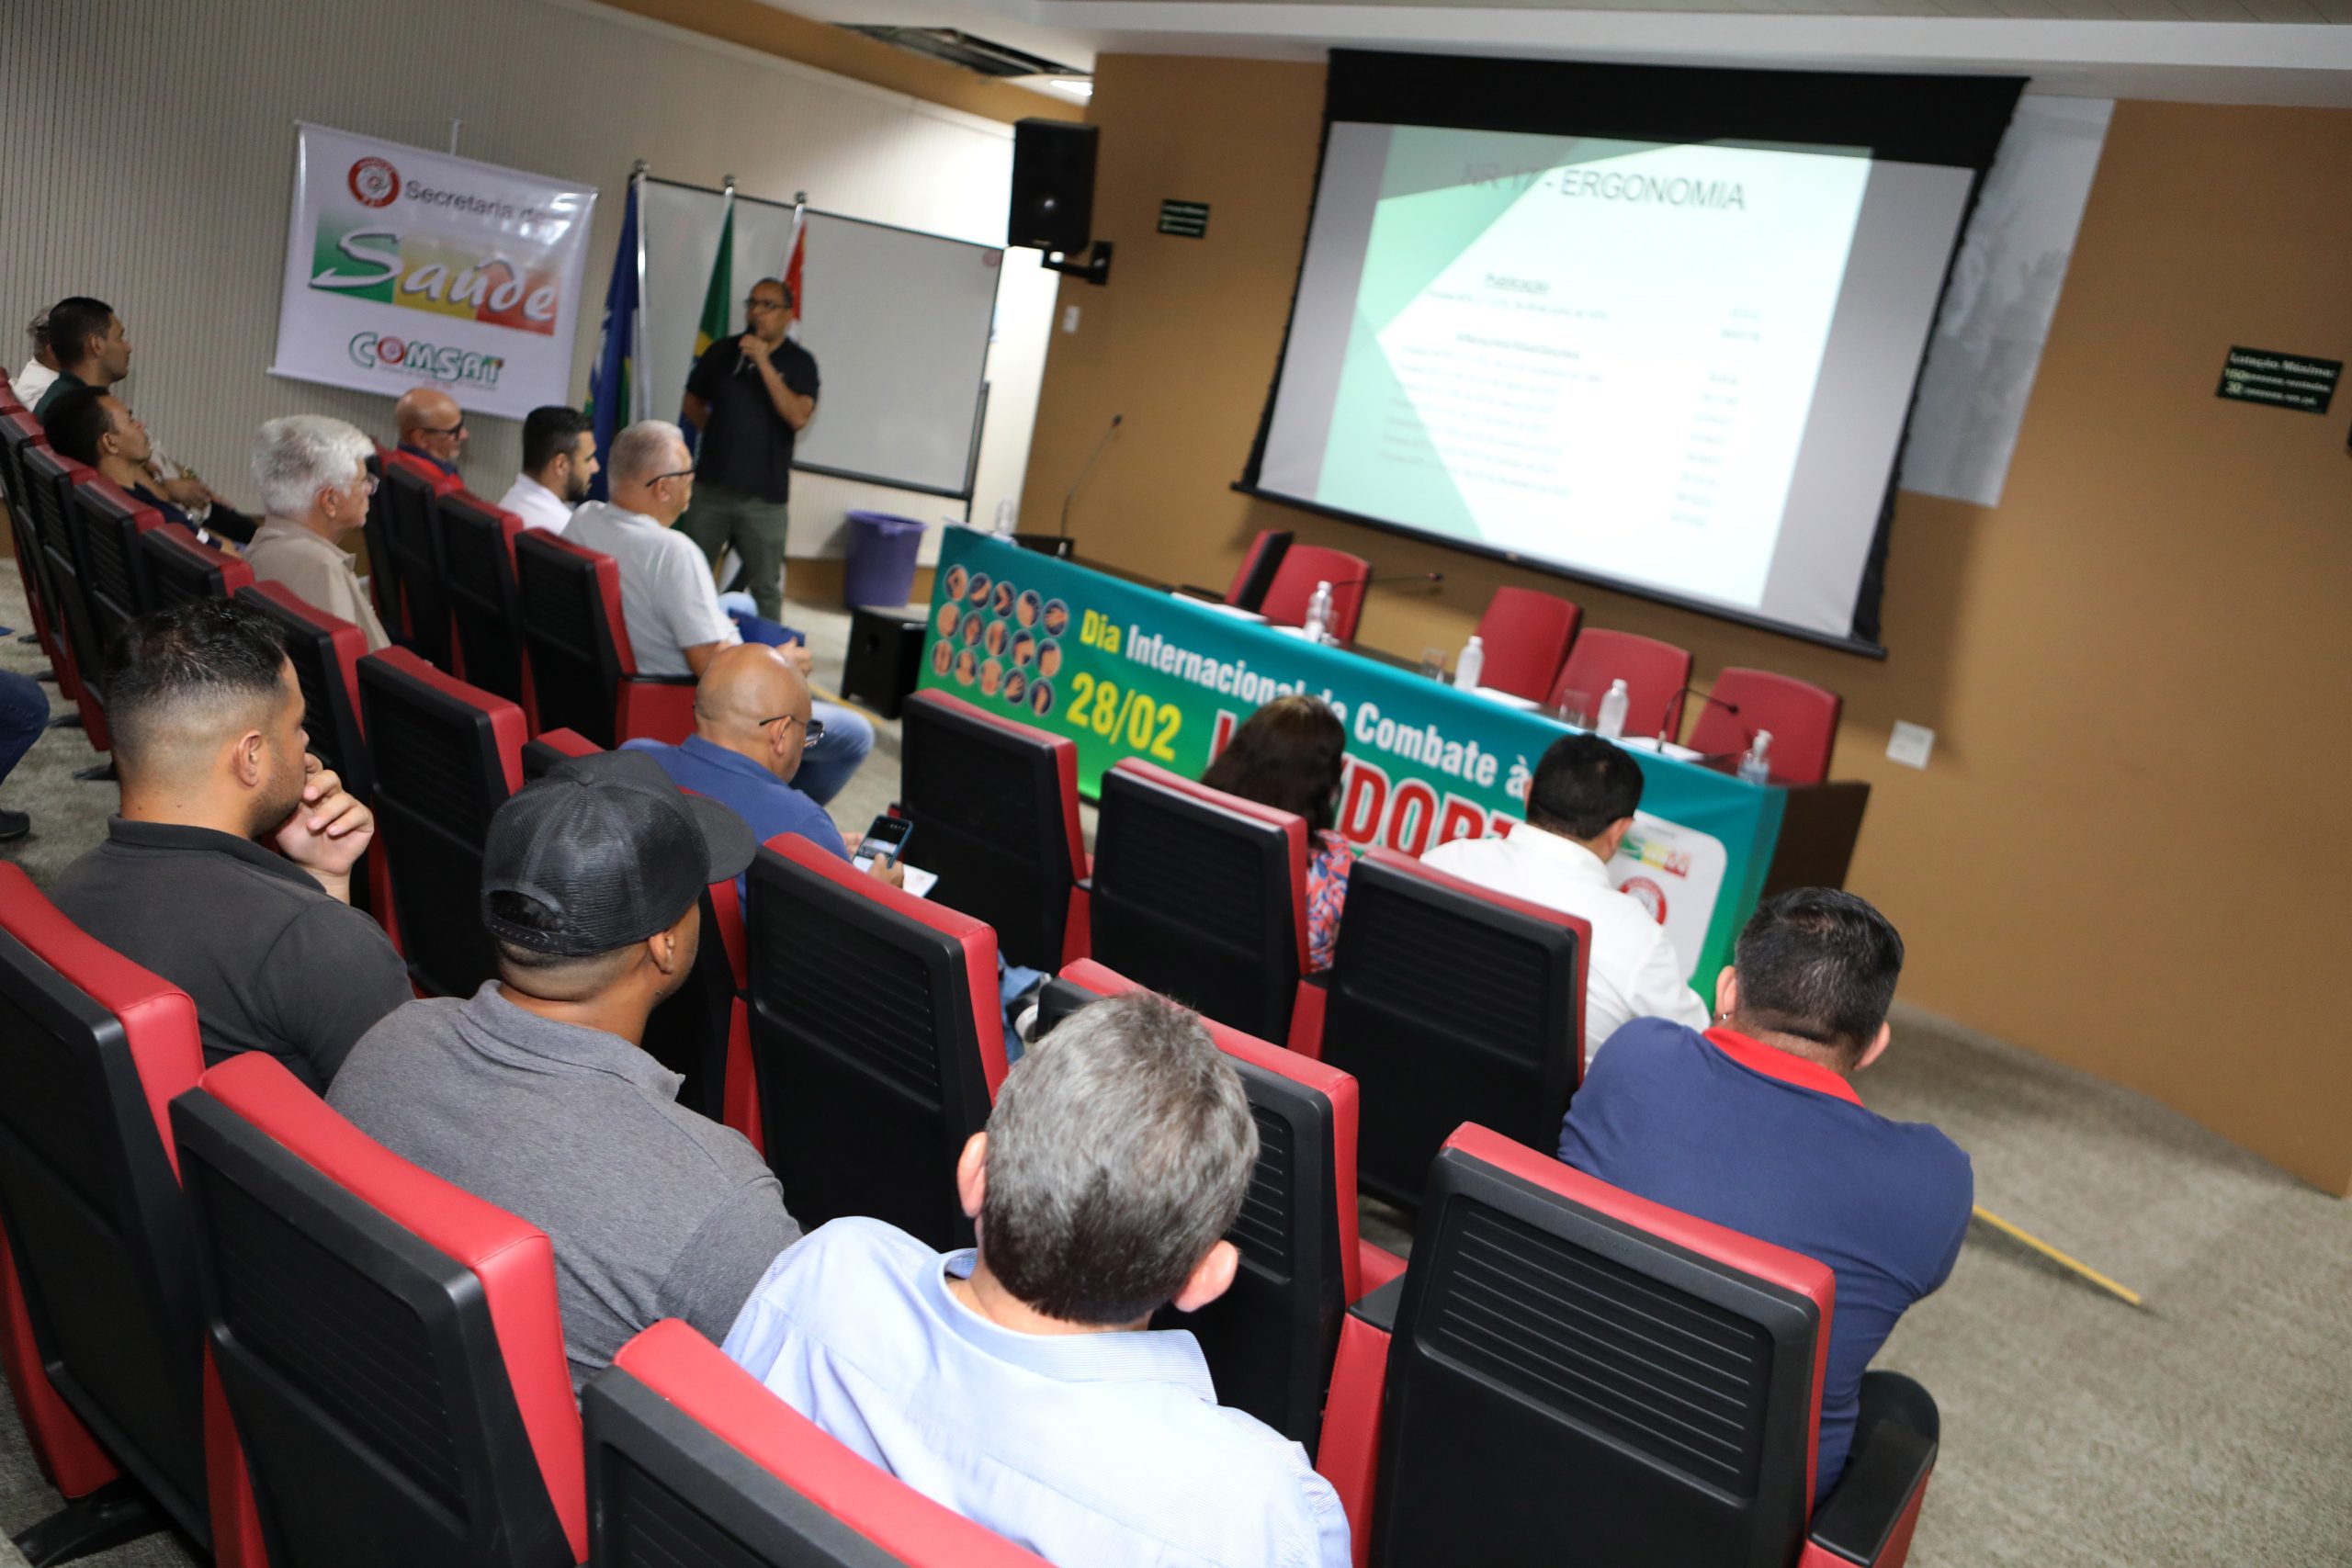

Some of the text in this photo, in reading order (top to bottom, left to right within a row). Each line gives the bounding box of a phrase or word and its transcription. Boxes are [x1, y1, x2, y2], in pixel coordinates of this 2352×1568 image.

[404, 180, 514, 220] Secretaria
[1560, 168, 1747, 210] ERGONOMIA
[309, 230, 557, 321] Saúde
[348, 332, 504, 383] COMSAT
[1066, 671, 1182, 761] 28/02
[1080, 609, 1121, 654] Dia
[1353, 702, 1498, 787] Combate
[1505, 755, 1533, 801] à
